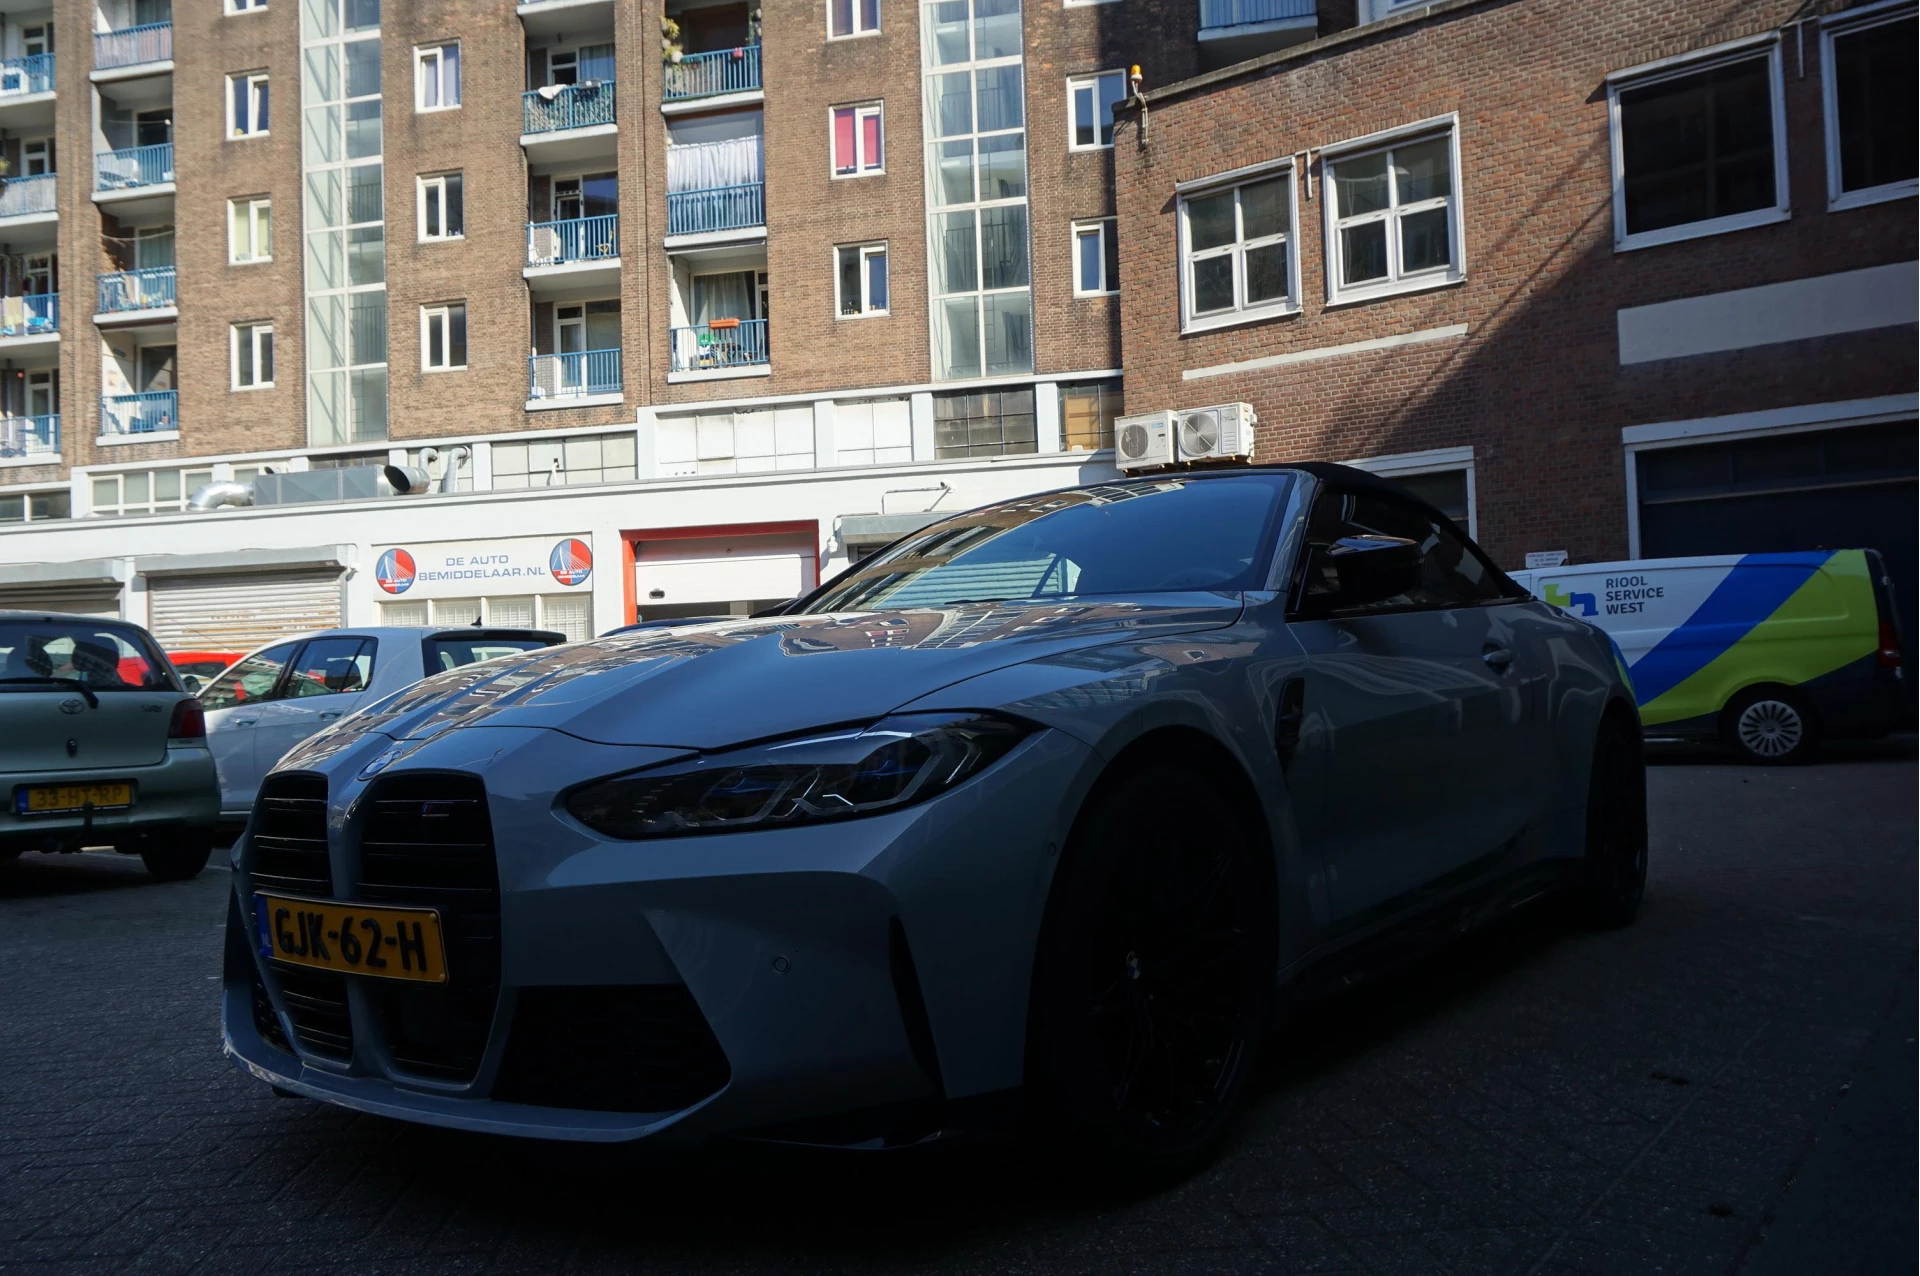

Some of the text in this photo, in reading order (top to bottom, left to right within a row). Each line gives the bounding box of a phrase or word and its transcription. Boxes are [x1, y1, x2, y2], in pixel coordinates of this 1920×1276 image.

[446, 555, 509, 566] DE AUTO
[418, 567, 546, 581] BEMIDDELAAR.NL
[1606, 576, 1648, 588] RIOOL
[1606, 587, 1664, 602] SERVICE
[1606, 602, 1645, 615] WEST
[275, 907, 427, 971] GJK-62-H
